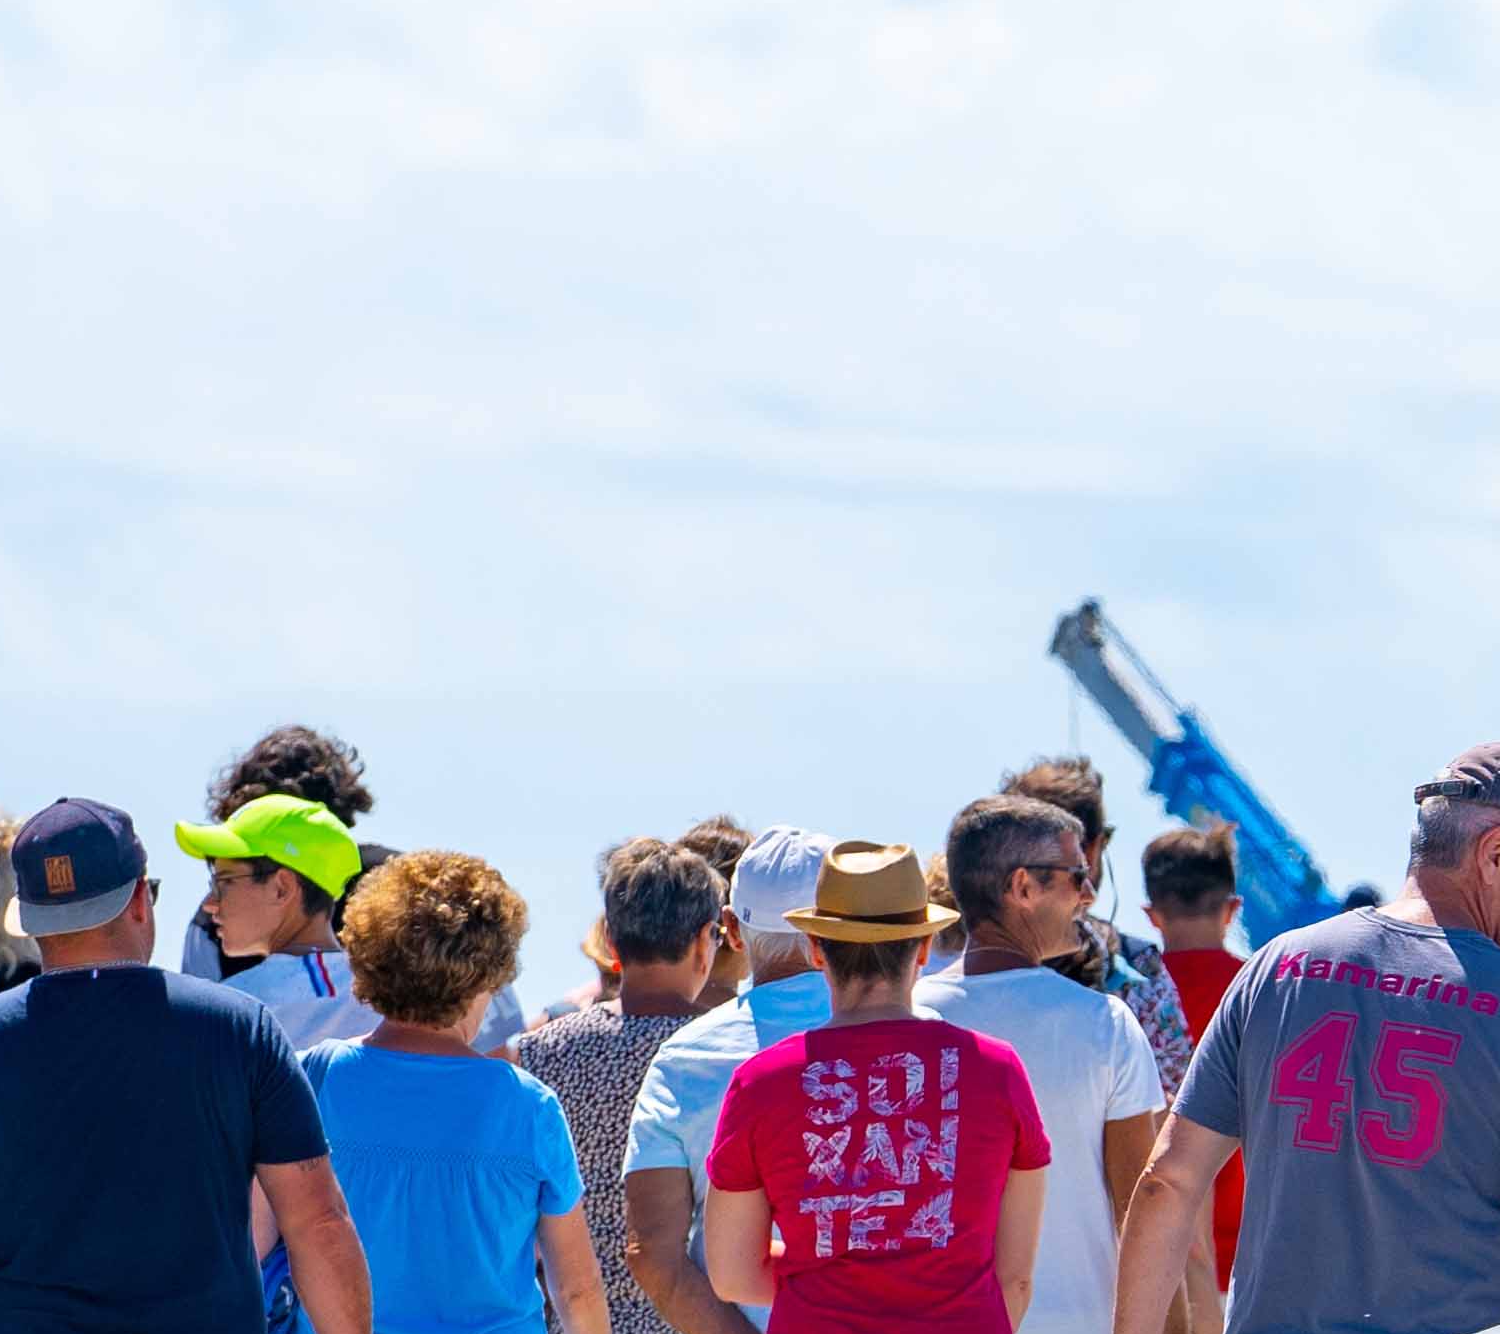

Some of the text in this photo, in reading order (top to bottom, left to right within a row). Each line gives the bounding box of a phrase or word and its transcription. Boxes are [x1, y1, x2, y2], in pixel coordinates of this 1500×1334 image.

[1275, 951, 1500, 1016] Kamarina
[1271, 1011, 1462, 1169] 45
[802, 1115, 960, 1187] XAN
